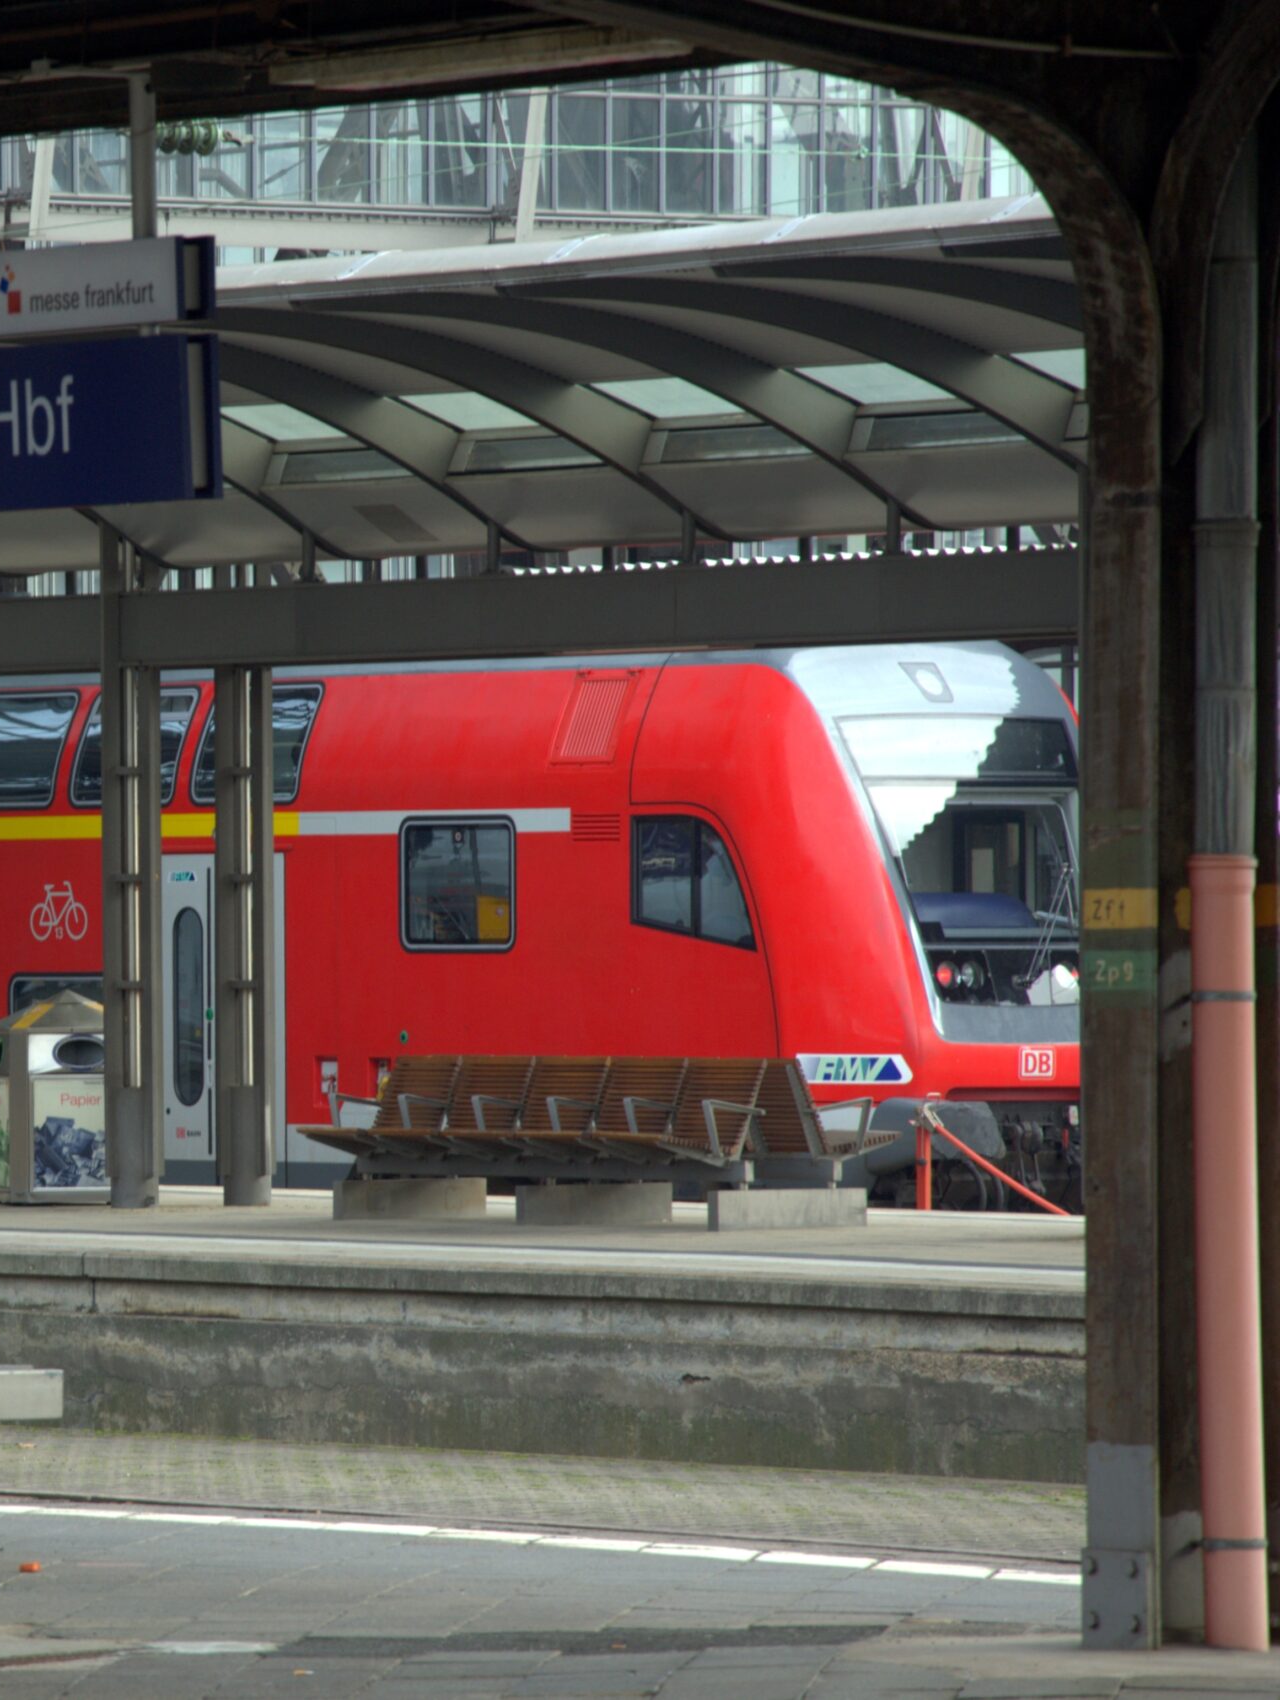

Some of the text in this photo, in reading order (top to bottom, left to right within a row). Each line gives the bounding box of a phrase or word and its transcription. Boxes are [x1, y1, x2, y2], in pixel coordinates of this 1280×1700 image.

[30, 280, 155, 313] messe frankfurt
[1022, 1051, 1052, 1075] DB
[60, 1092, 102, 1108] Papier
